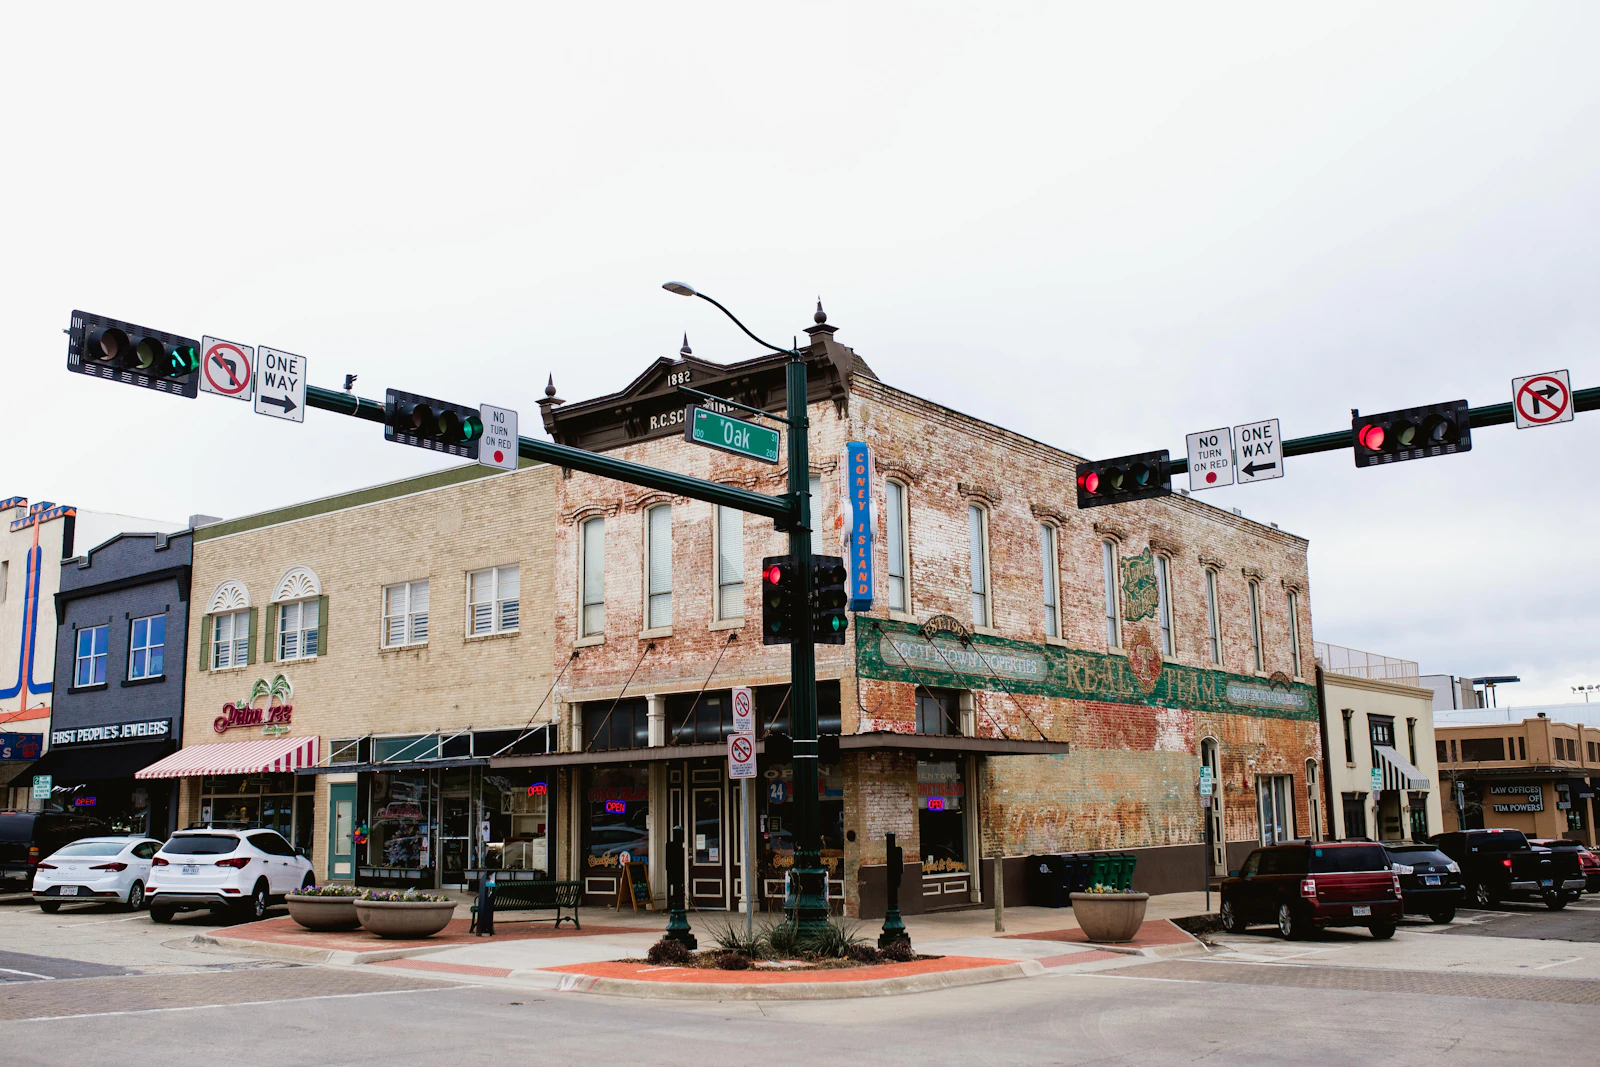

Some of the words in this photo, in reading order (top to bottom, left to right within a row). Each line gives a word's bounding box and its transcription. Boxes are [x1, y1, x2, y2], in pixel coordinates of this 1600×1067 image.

[266, 354, 298, 375] ONE
[265, 371, 299, 392] WAY
[667, 371, 691, 387] 1882
[493, 411, 505, 424] NO
[490, 424, 509, 437] TURN
[694, 427, 705, 439] 100
[724, 422, 751, 450] Oak
[771, 434, 778, 442] St
[1242, 425, 1272, 442] ONE
[485, 435, 496, 447] ON
[498, 438, 512, 450] RED
[1199, 435, 1218, 448] NO
[766, 448, 777, 459] 200
[1198, 449, 1222, 460] TURN
[1242, 440, 1274, 458] WAY
[1194, 463, 1207, 472] ON
[1210, 459, 1228, 470] RED
[855, 452, 867, 511] CONEY
[857, 523, 869, 595] ISLAND
[893, 640, 930, 661] SCOTT
[933, 647, 976, 668] BROWN
[976, 654, 1037, 674] PROPERTIES
[1065, 652, 1132, 695] REAL
[1163, 667, 1219, 705] TEAM
[52, 730, 78, 744] FIRST
[77, 725, 119, 742] PEOPLE'S
[120, 720, 169, 738] JEWELERS
[528, 785, 547, 797] OPEN
[588, 787, 618, 802] CONEY
[770, 783, 784, 800] 24
[1490, 786, 1506, 794] LAW
[1508, 785, 1539, 794] OFFICES
[75, 797, 95, 805] OPEN
[929, 799, 943, 809] OPEN
[1528, 794, 1540, 803] OF
[607, 801, 625, 812] OPEN
[1494, 804, 1509, 812] TIM
[1510, 803, 1541, 812] POWERS
[621, 853, 630, 863] 24
